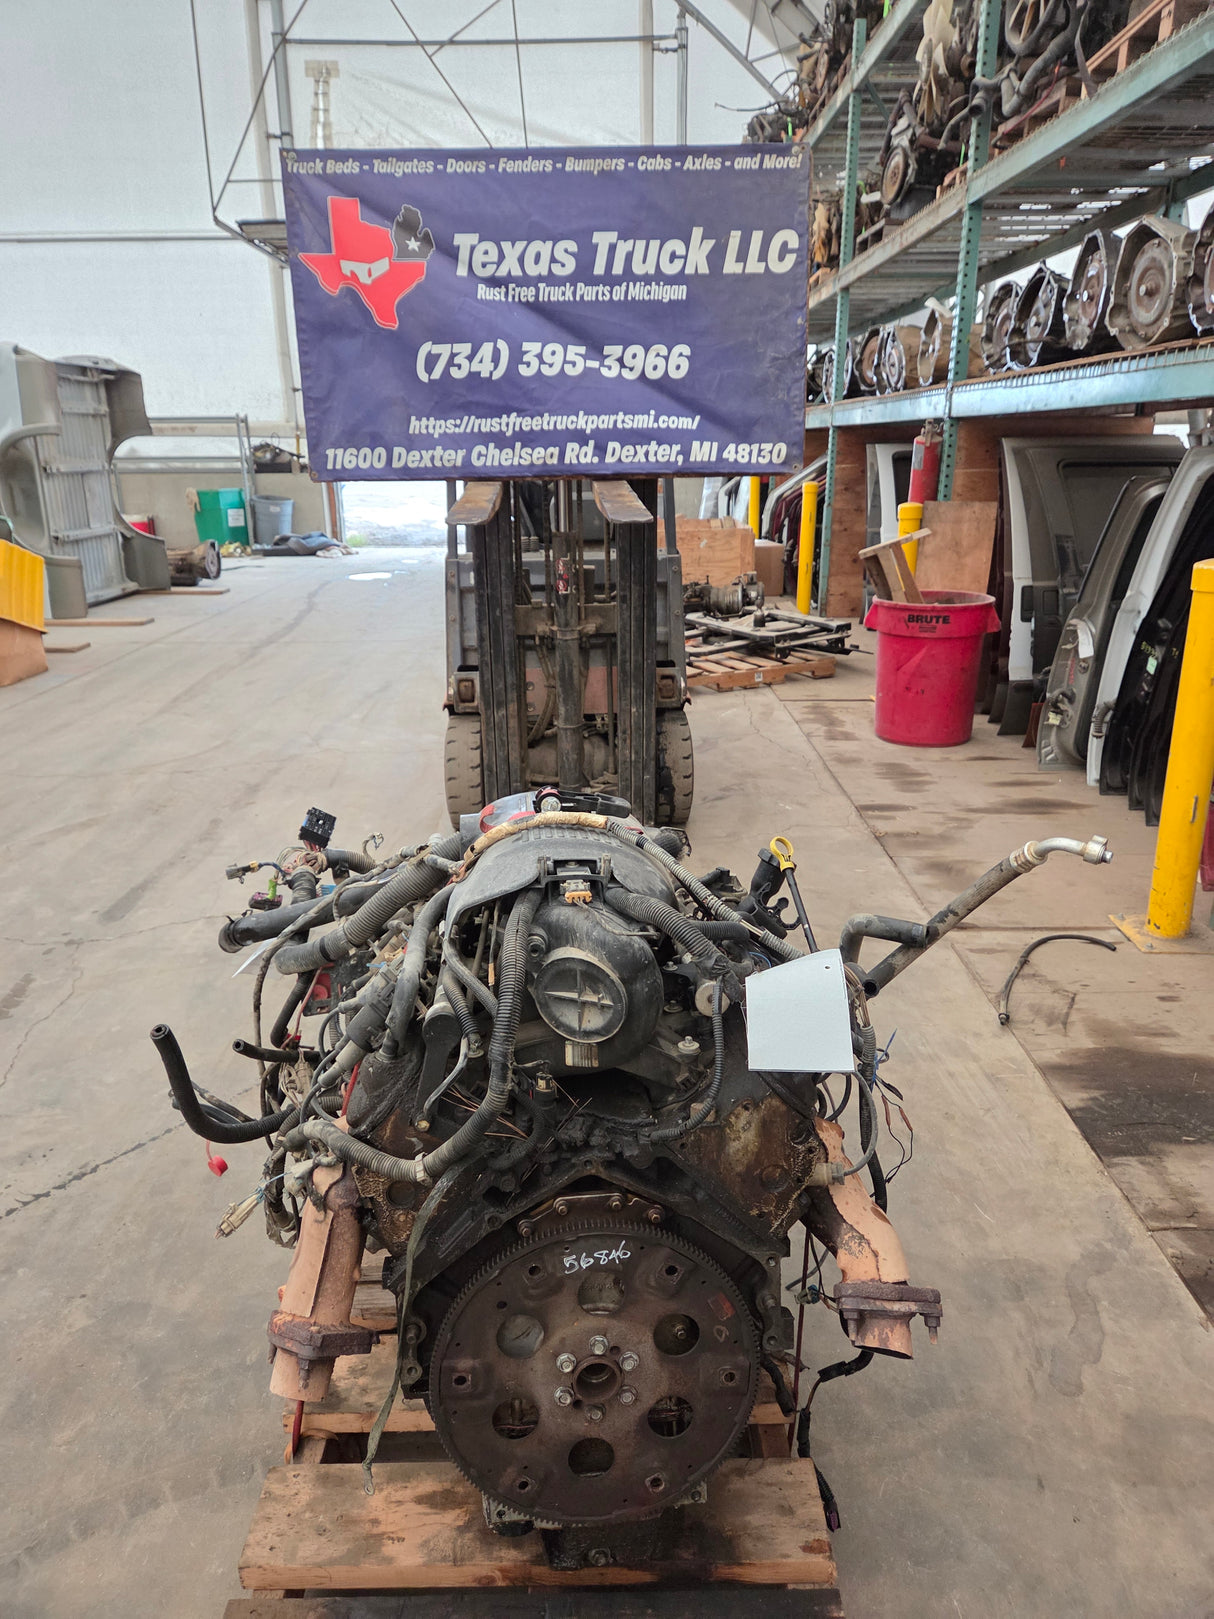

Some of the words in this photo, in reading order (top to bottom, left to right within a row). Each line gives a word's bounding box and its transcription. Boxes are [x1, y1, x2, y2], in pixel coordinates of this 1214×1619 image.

[286, 157, 323, 174] Truck
[326, 157, 361, 174] Beds
[372, 157, 435, 177] Tailgates
[446, 157, 486, 173] Doors
[498, 156, 553, 173] Fenders
[565, 156, 625, 176] Bumpers
[637, 155, 672, 171] Cabs
[683, 154, 722, 170] Axles
[734, 153, 760, 170] and
[762, 153, 803, 169] More!
[453, 233, 578, 277] Texas
[592, 226, 716, 275] Truck
[723, 229, 799, 275] LLC
[477, 283, 507, 301] Rust
[508, 283, 536, 302] Free
[537, 282, 575, 302] Truck
[576, 282, 610, 301] Parts
[612, 282, 627, 301] of
[627, 281, 687, 303] Michigan
[416, 338, 510, 383] (734)
[517, 341, 691, 380] 395-3966
[408, 410, 701, 438] https://rustfreetruckpartsmi.com/
[325, 447, 387, 470] 11600
[391, 445, 466, 468] Dexter
[470, 442, 559, 467] Chelsea
[564, 440, 599, 464] Rd.
[605, 440, 683, 466] Dexter,
[689, 440, 718, 462] MI
[722, 441, 788, 464] 48130
[907, 614, 951, 624] BRUTE
[563, 1240, 631, 1274] 56846
